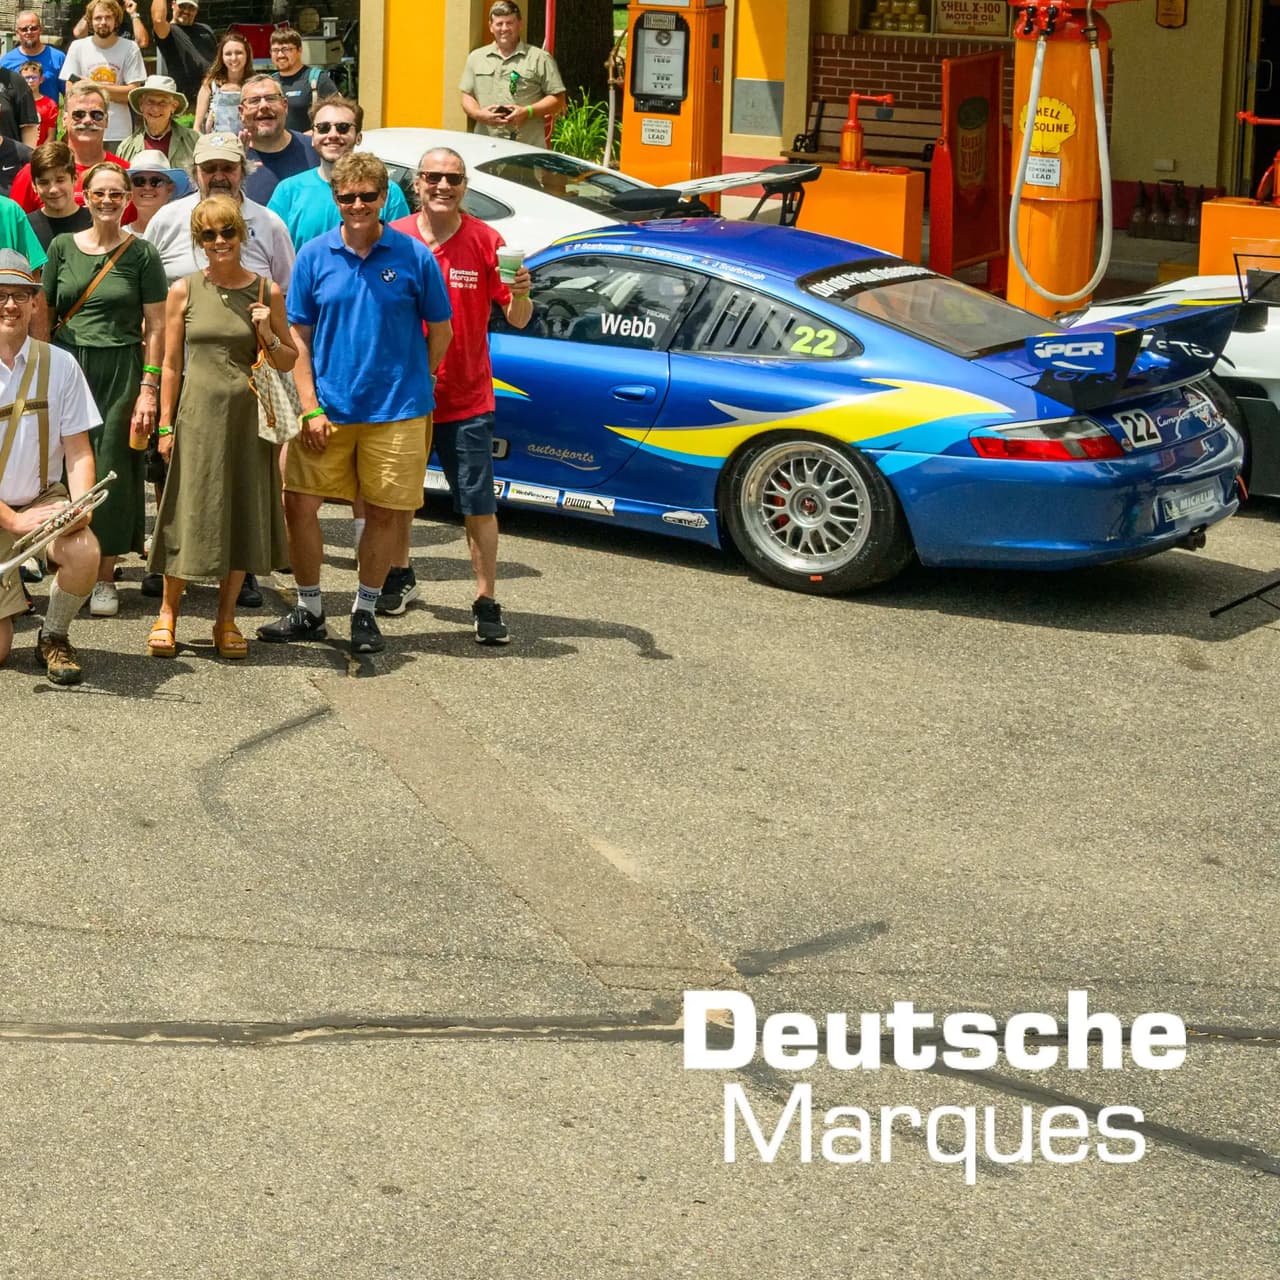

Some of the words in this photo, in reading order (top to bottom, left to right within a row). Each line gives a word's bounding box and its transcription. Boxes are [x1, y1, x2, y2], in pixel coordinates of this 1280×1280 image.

[941, 0, 969, 12] SHELL
[972, 2, 1000, 14] X-100
[946, 13, 978, 21] MOTOR
[981, 14, 996, 22] OIL
[1036, 107, 1061, 120] HELL
[1024, 121, 1070, 133] SOLINE
[449, 268, 479, 276] Deutsche
[450, 273, 478, 282] Marques
[600, 312, 656, 339] Webb
[789, 325, 839, 357] 22
[1121, 412, 1158, 443] 22
[527, 443, 595, 463] autosports
